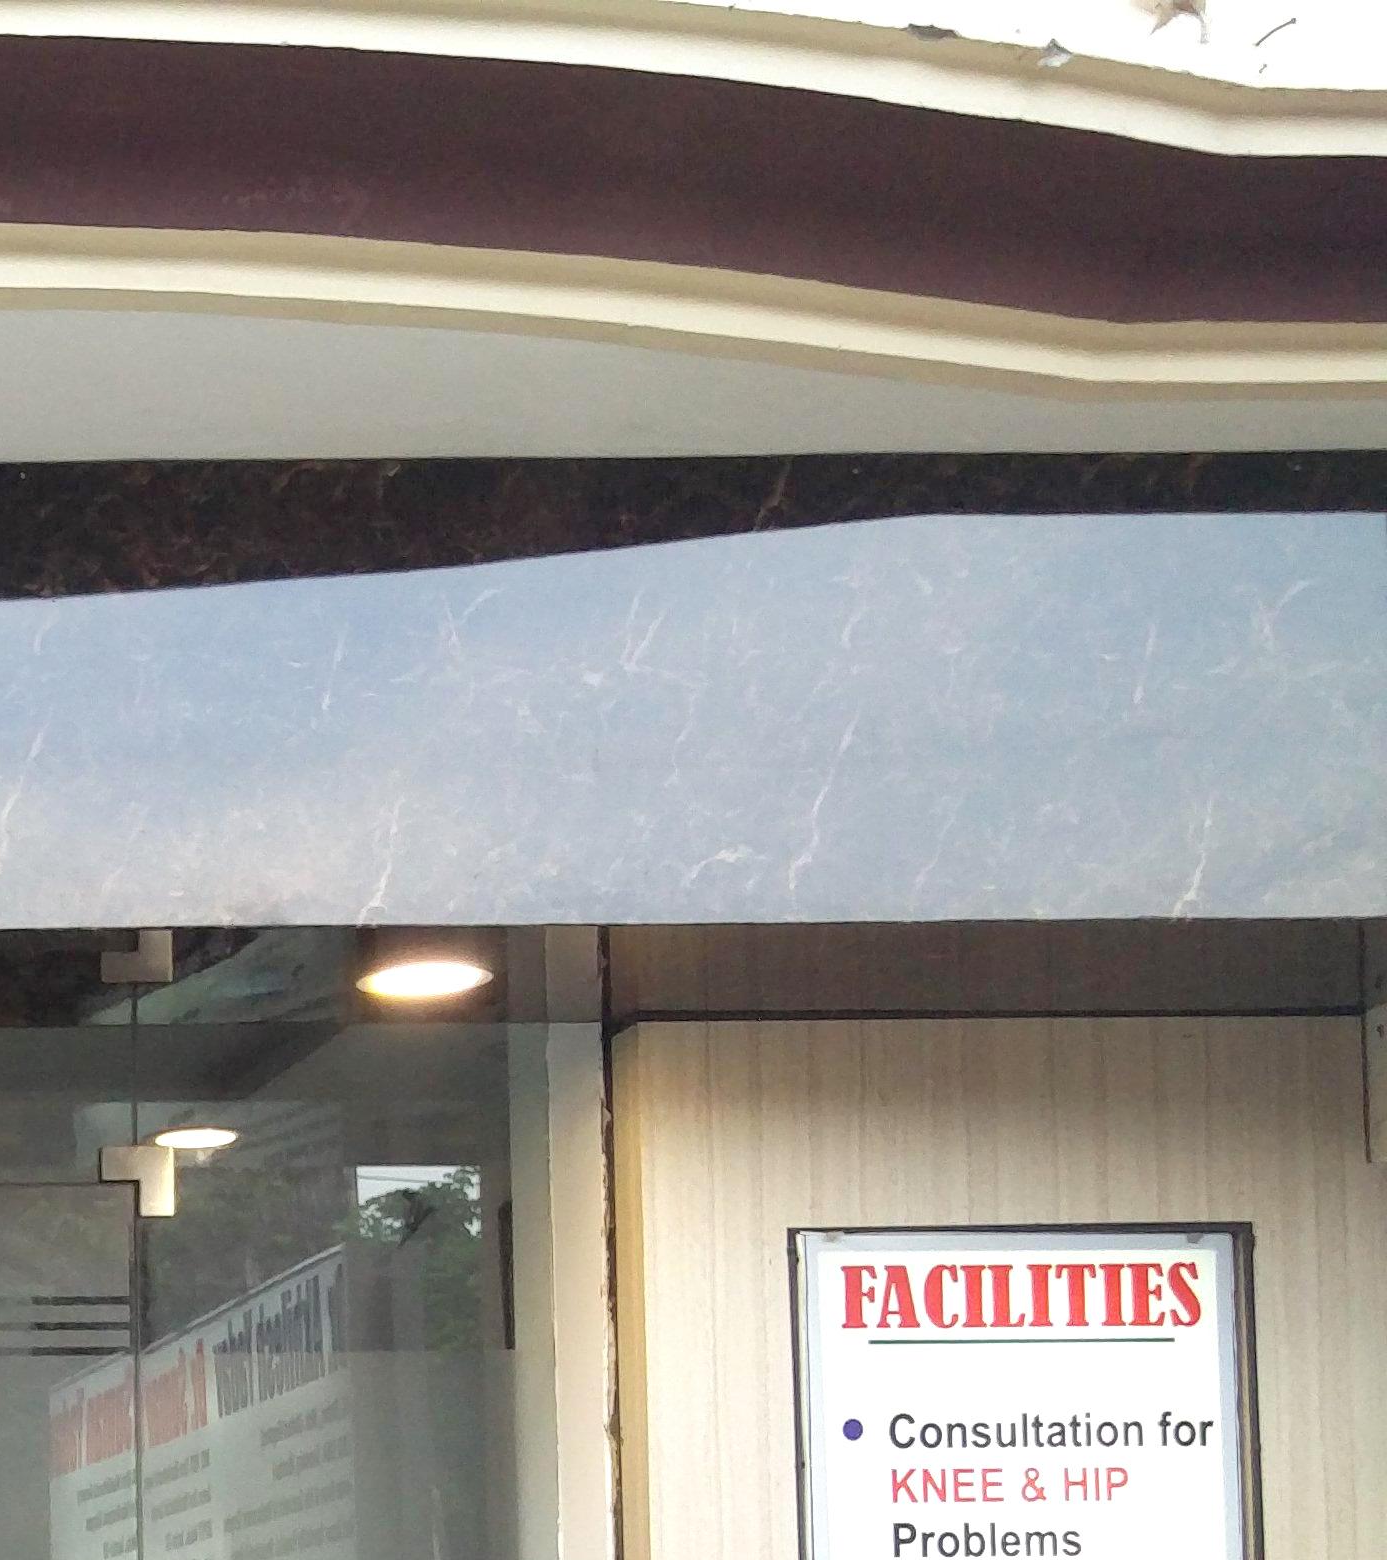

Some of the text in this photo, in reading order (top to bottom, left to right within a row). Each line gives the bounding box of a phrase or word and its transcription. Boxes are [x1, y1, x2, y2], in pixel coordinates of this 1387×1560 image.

[841, 1262, 1202, 1329] FACILITIES
[889, 1412, 1213, 1448] Consultation for
[891, 1467, 1130, 1503] KNEE & HIP
[892, 1523, 1082, 1557] Problems
